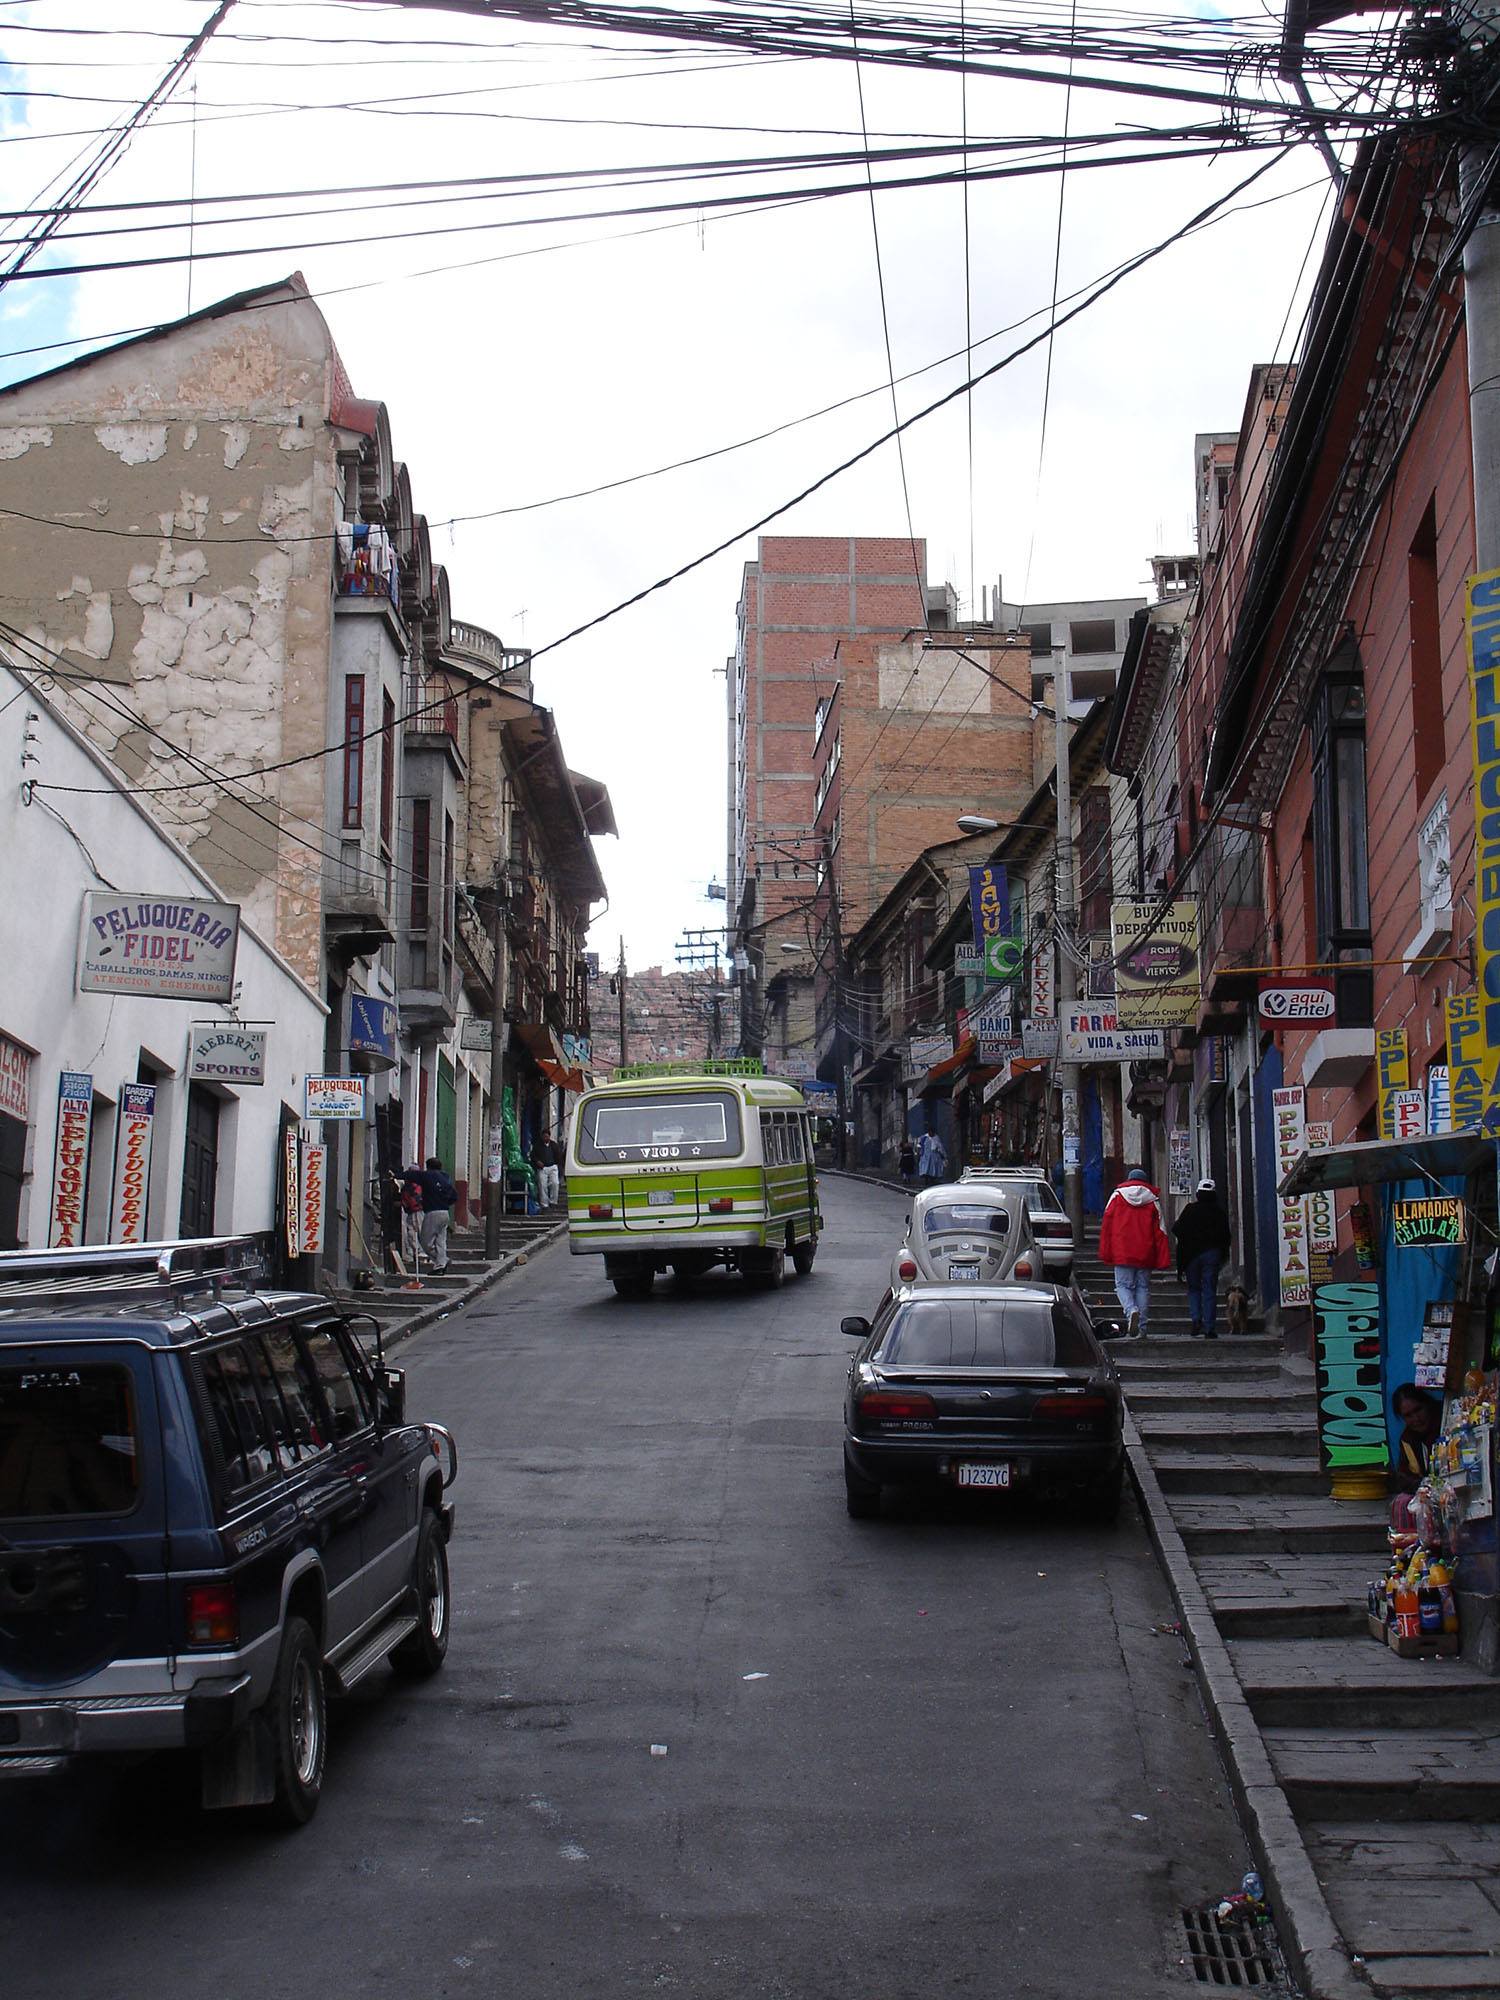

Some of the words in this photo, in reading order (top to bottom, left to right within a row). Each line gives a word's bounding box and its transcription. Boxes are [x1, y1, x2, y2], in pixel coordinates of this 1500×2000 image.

[93, 904, 232, 949] PELUQUERIA
[1290, 991, 1326, 1006] aqui
[1448, 995, 1479, 1019] SE
[1288, 1003, 1330, 1016] Entel
[251, 1034, 264, 1042] 211
[1087, 1036, 1114, 1049] VIDA
[1124, 1034, 1159, 1048] SALUD
[1379, 1029, 1403, 1048] SE
[196, 1033, 260, 1062] HEBERT'S
[0, 1040, 29, 1084] LON
[195, 1062, 261, 1077] SPORTS
[125, 1085, 155, 1098] BARBER
[308, 1079, 363, 1097] PELUQUERIA
[63, 1098, 89, 1114] ALTA
[128, 1095, 149, 1105] SHOP
[1398, 1093, 1422, 1103] ALTA
[53, 1111, 88, 1249] PELUQUERIA
[304, 1151, 322, 1251] PELUQUERIA
[1395, 1200, 1456, 1220] LLAMADAS
[1395, 1218, 1458, 1244] CELULAR
[1312, 1240, 1336, 1251] UNISEX
[1314, 1283, 1387, 1446] SELLOS
[960, 1469, 1008, 1485] 1123ZYC
